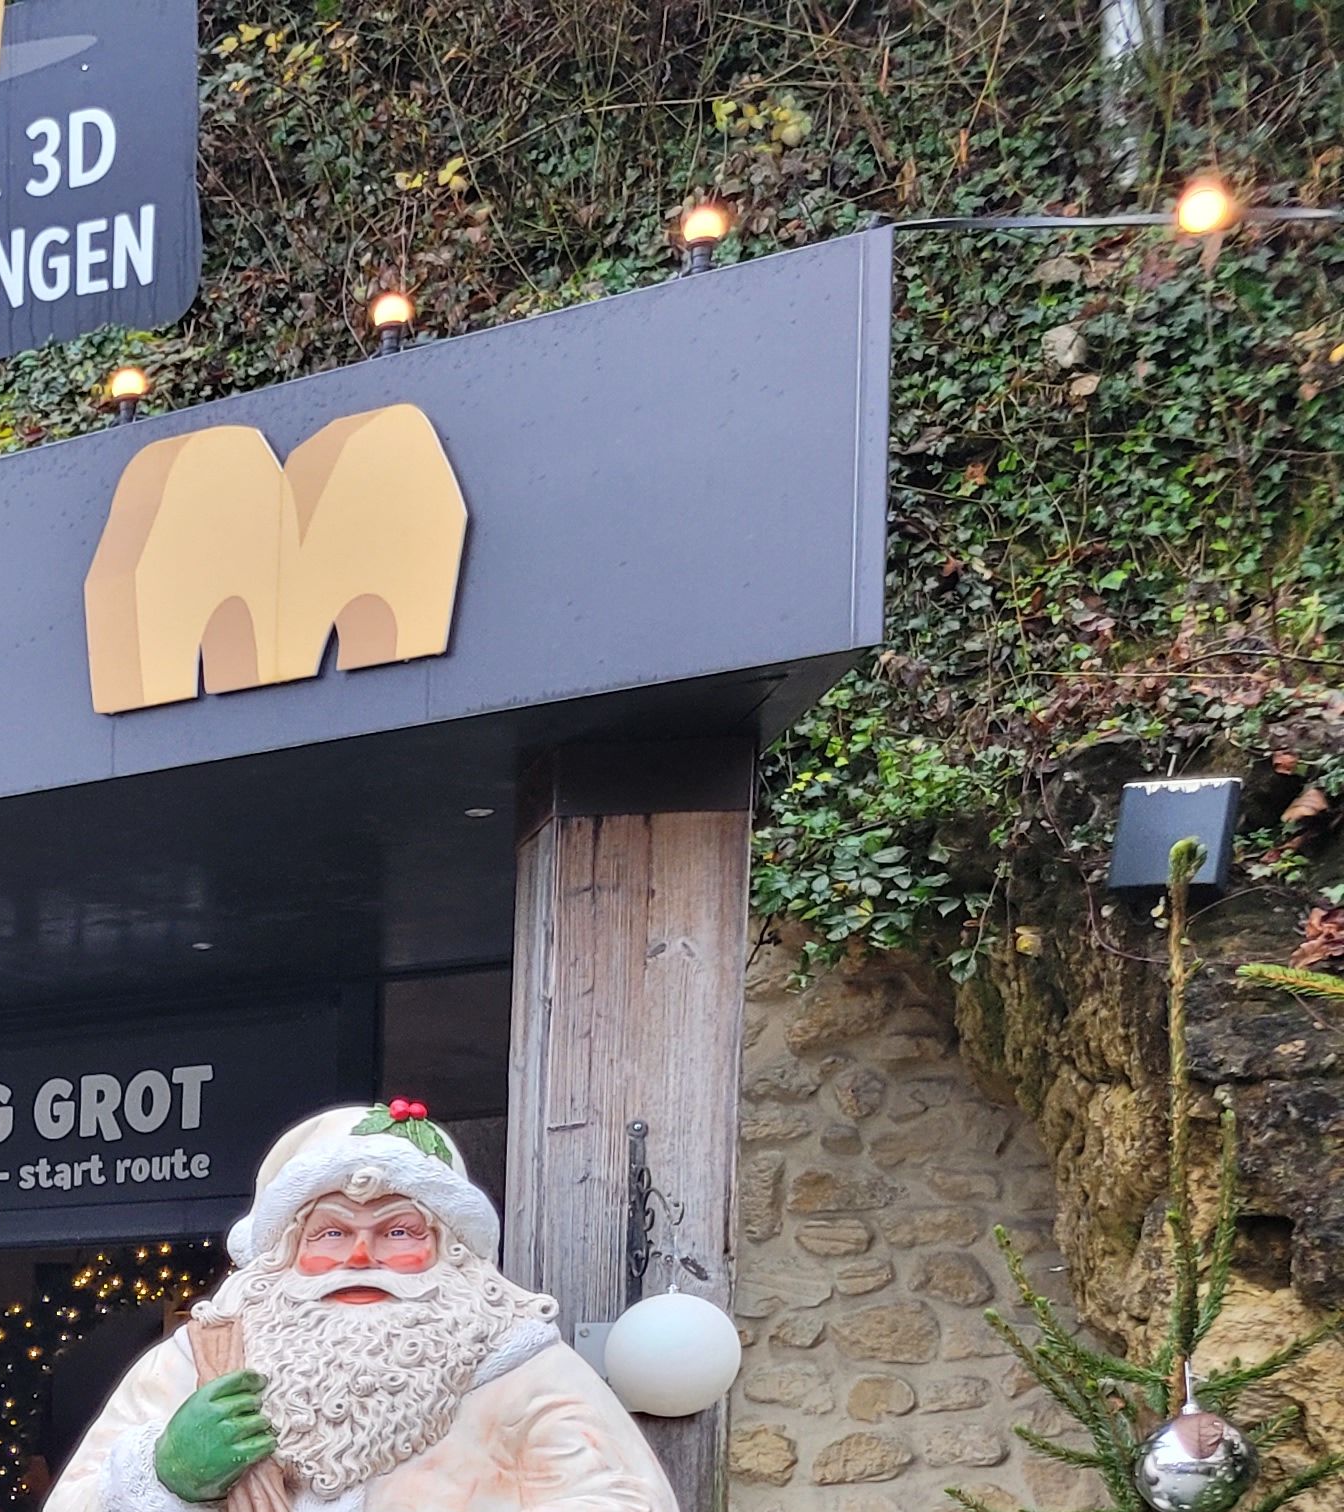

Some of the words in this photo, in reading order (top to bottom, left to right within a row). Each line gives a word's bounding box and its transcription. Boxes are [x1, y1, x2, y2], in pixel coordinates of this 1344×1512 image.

[25, 108, 116, 198] 3D
[33, 1064, 214, 1142] GROT
[18, 1154, 106, 1191] start
[116, 1148, 210, 1184] route
